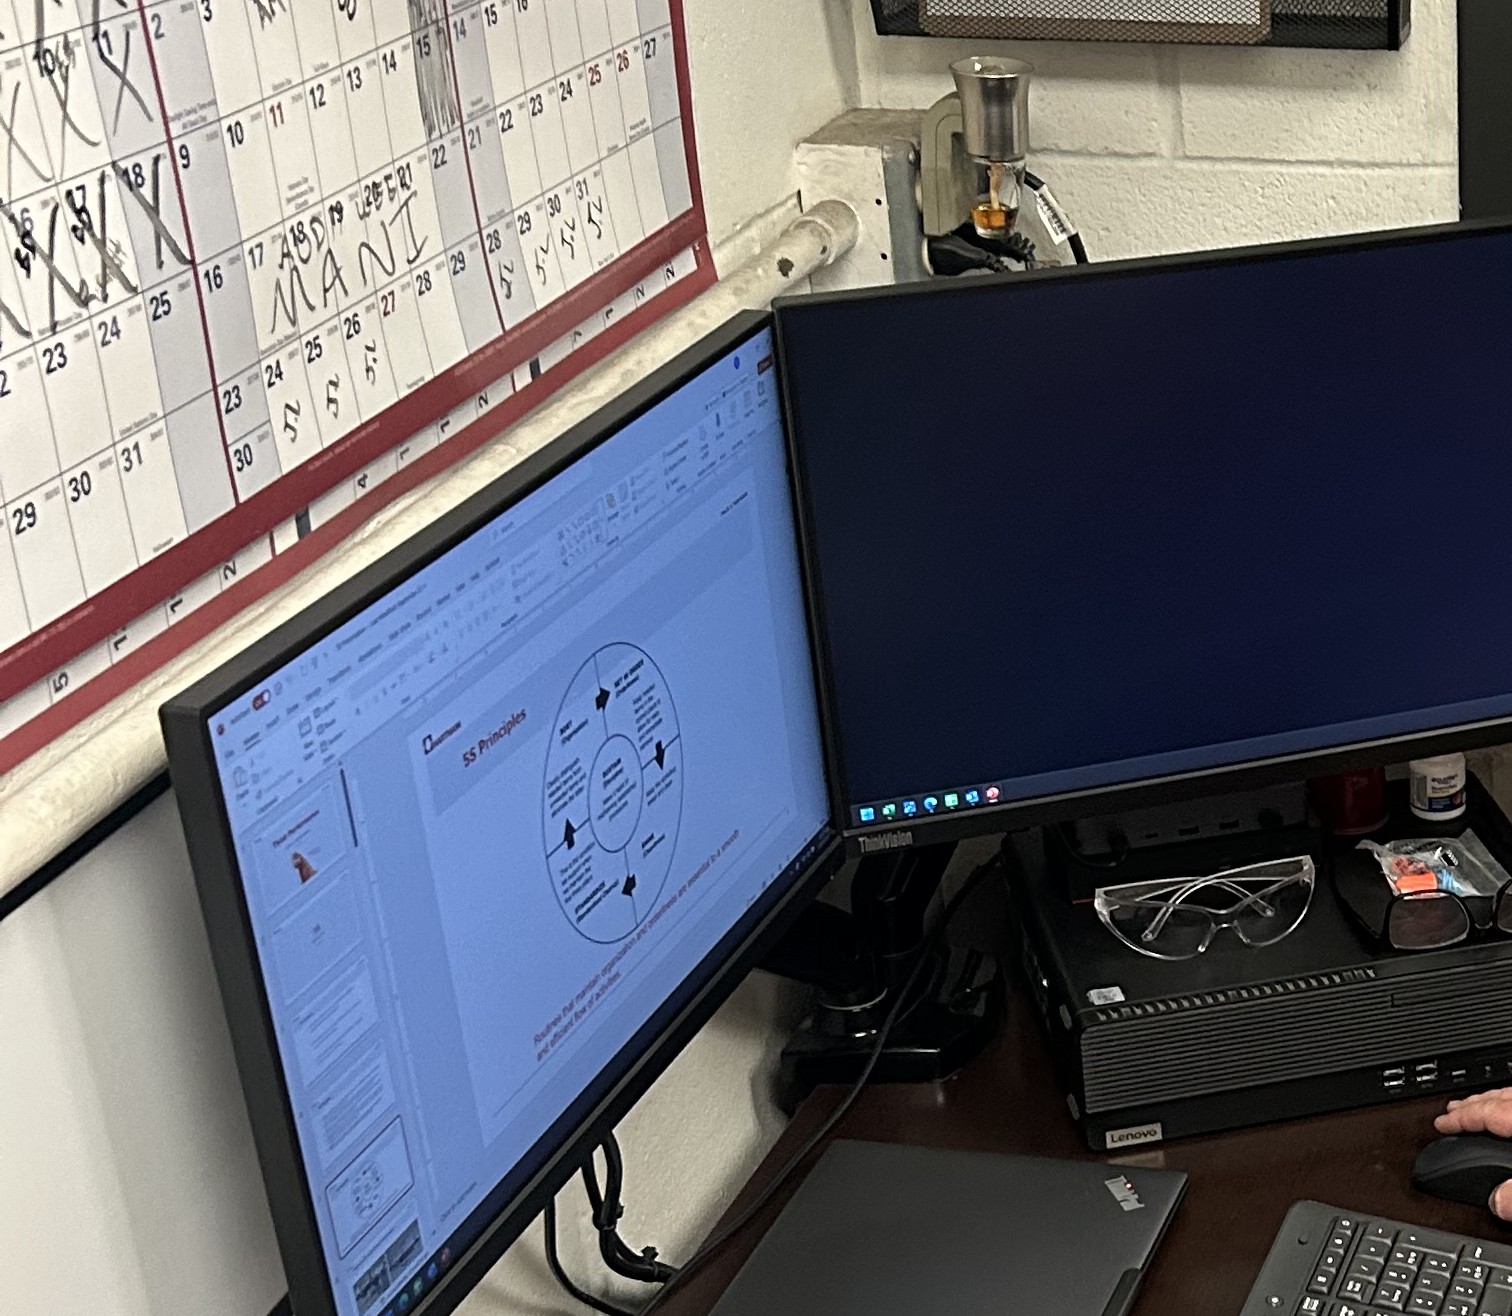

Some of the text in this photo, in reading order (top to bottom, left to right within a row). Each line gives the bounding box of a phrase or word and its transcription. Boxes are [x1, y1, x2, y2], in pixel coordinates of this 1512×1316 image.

[151, 13, 165, 40] 2
[484, 3, 498, 27] 15
[453, 18, 468, 40] 14
[416, 35, 431, 59] 15
[643, 38, 657, 60] 27
[382, 50, 397, 74] 14
[588, 64, 602, 86] 25
[616, 50, 630, 74] 26
[346, 66, 362, 92] 13
[559, 79, 573, 102] 24
[309, 83, 326, 110] 12
[529, 94, 544, 118] 23
[269, 102, 285, 127] 11
[499, 109, 514, 133] 22
[226, 120, 244, 148] 10
[467, 126, 483, 150] 21
[179, 144, 191, 170] 9
[432, 145, 448, 170] 22
[575, 177, 589, 201] 31
[547, 193, 562, 218] 30
[517, 211, 532, 236] 29
[486, 229, 502, 254] 28
[249, 241, 264, 270] 17
[450, 250, 466, 276] 29
[203, 265, 223, 293] 16
[415, 270, 432, 297] 28
[150, 291, 172, 322] 25
[380, 290, 397, 318] 27
[98, 316, 121, 348] 24
[343, 312, 361, 340] 26
[42, 342, 68, 375] 23
[304, 335, 323, 363] 25
[265, 359, 284, 388] 24
[222, 385, 243, 414] 23
[121, 441, 144, 472] 31
[233, 443, 253, 472] 30
[68, 471, 92, 502] 30
[12, 501, 38, 535] 29
[1110, 1128, 1157, 1144] Lenovo
